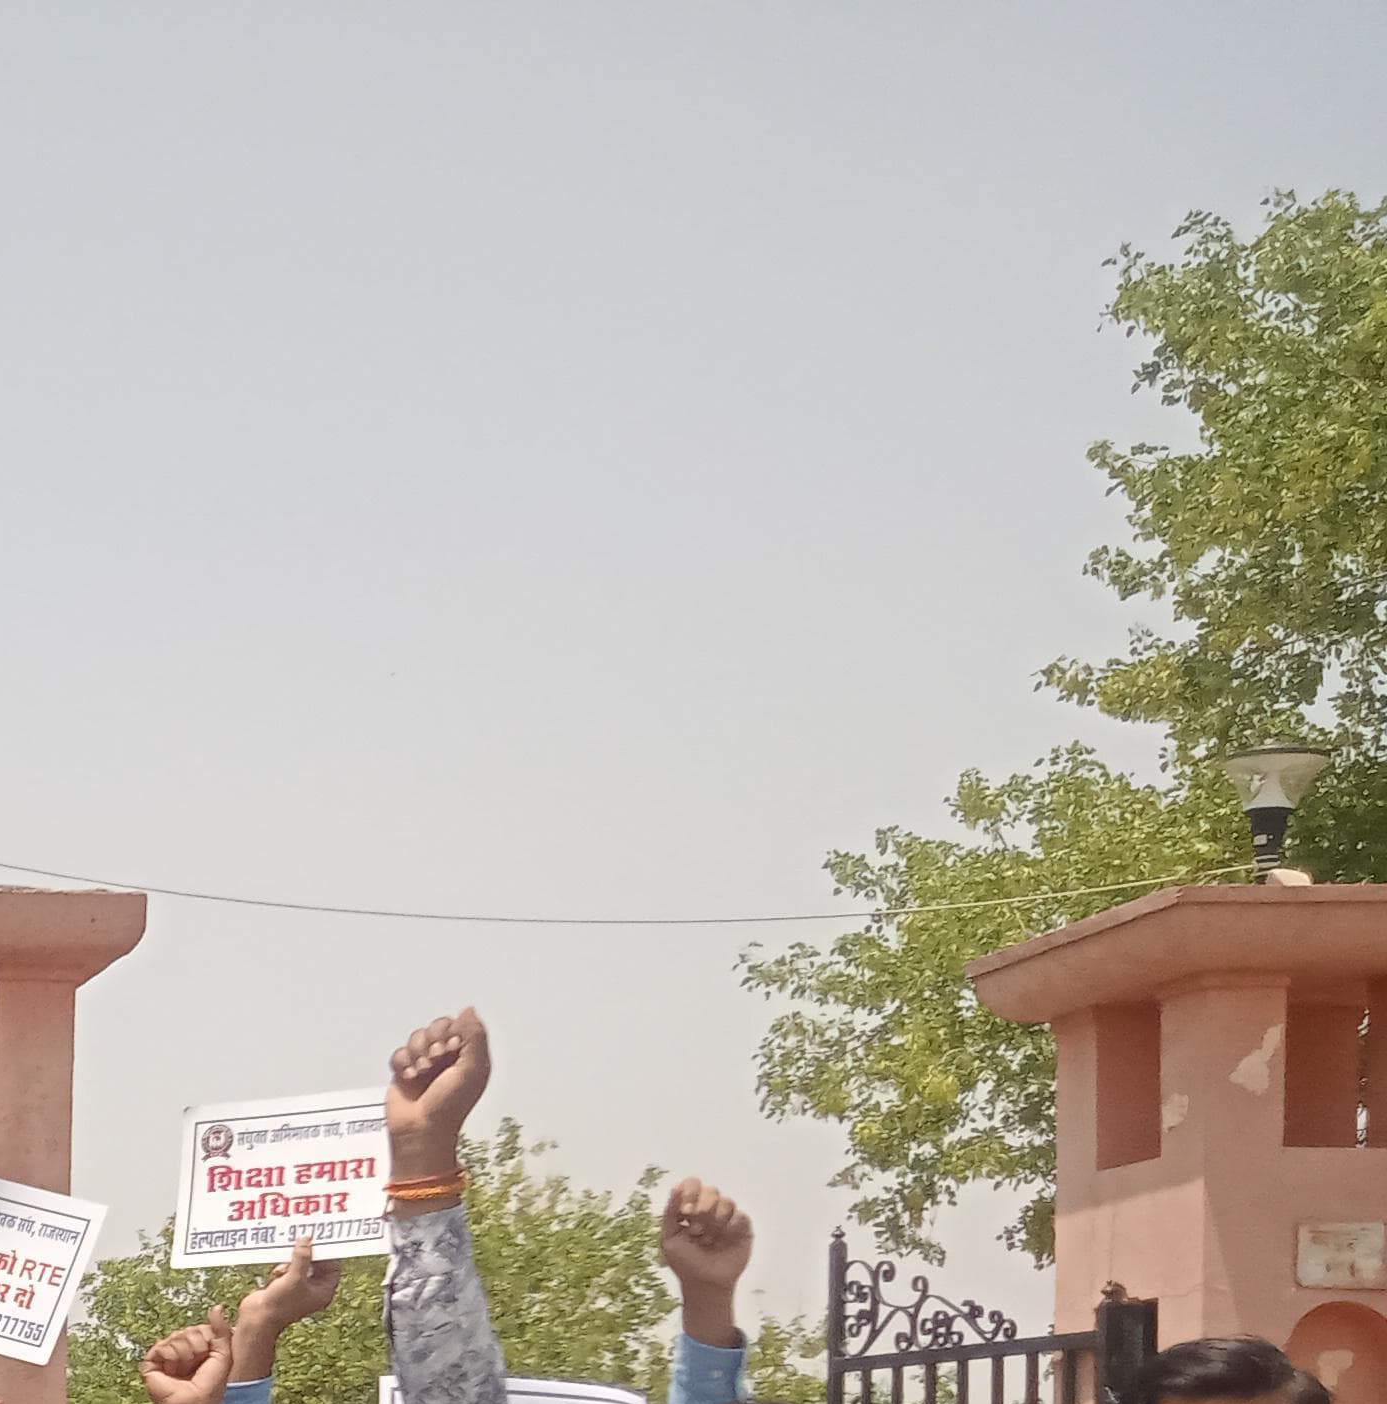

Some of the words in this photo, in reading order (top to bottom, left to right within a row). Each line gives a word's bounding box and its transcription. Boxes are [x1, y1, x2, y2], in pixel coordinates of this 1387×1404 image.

[206, 1164, 285, 1192] शिक्षा
[293, 1157, 375, 1184] हमारा
[227, 1191, 349, 1221] अधिकार
[18, 1258, 65, 1286] RTE
[13, 1284, 35, 1309] दो
